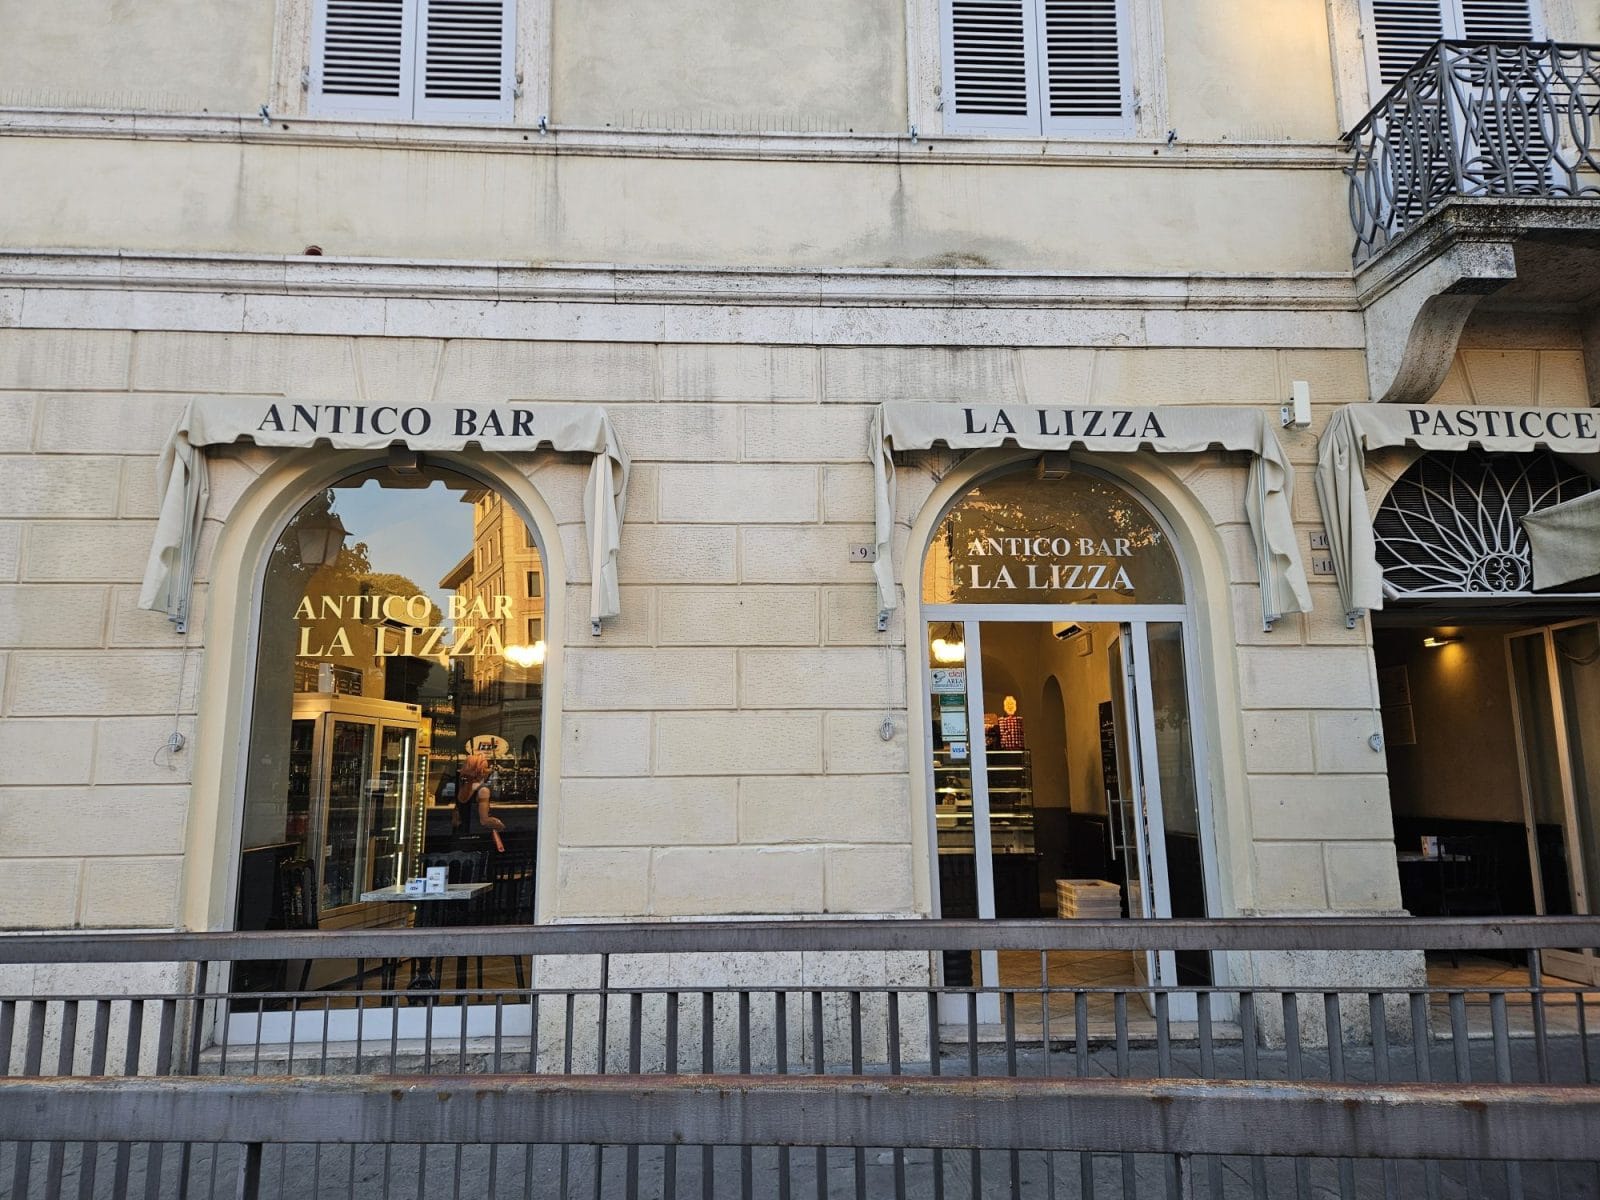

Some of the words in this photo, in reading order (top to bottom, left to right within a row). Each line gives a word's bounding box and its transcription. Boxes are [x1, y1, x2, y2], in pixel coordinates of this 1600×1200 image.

[257, 403, 431, 436] ANTICO
[453, 408, 535, 437] BAR
[963, 408, 1017, 434] LA
[1037, 409, 1167, 438] LIZZA
[1406, 409, 1600, 439] PASTICCE
[859, 547, 868, 558] 9
[967, 537, 1071, 557] ANTICO
[1079, 538, 1134, 557] BAR
[968, 564, 1018, 590] LA
[1026, 564, 1136, 590] LIZZA
[1322, 560, 1333, 571] 11
[292, 594, 433, 620] ANTICO
[447, 594, 514, 620] BAR
[295, 626, 355, 657] LA
[372, 626, 506, 657] LIZZA
